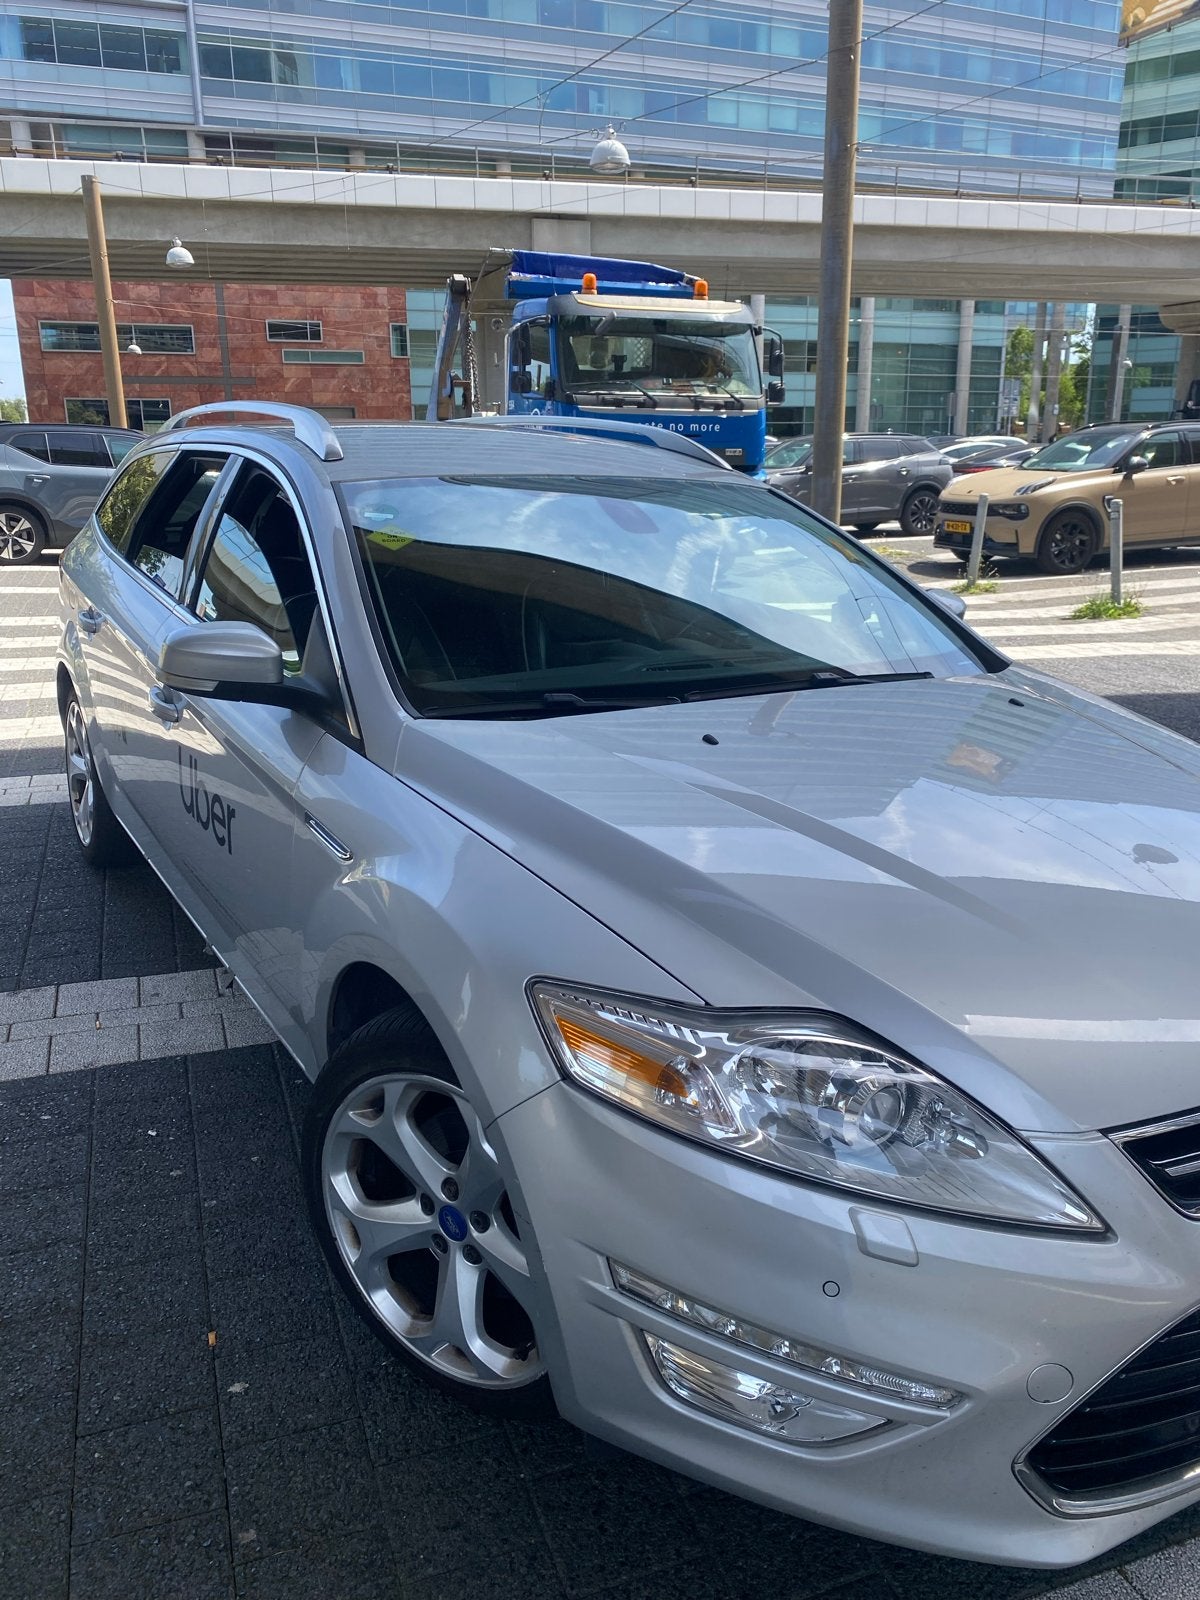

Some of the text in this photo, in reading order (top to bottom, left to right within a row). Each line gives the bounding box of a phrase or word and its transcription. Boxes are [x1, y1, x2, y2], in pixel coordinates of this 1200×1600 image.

[669, 422, 684, 431] no
[689, 422, 721, 432] more
[178, 744, 236, 856] Uber
